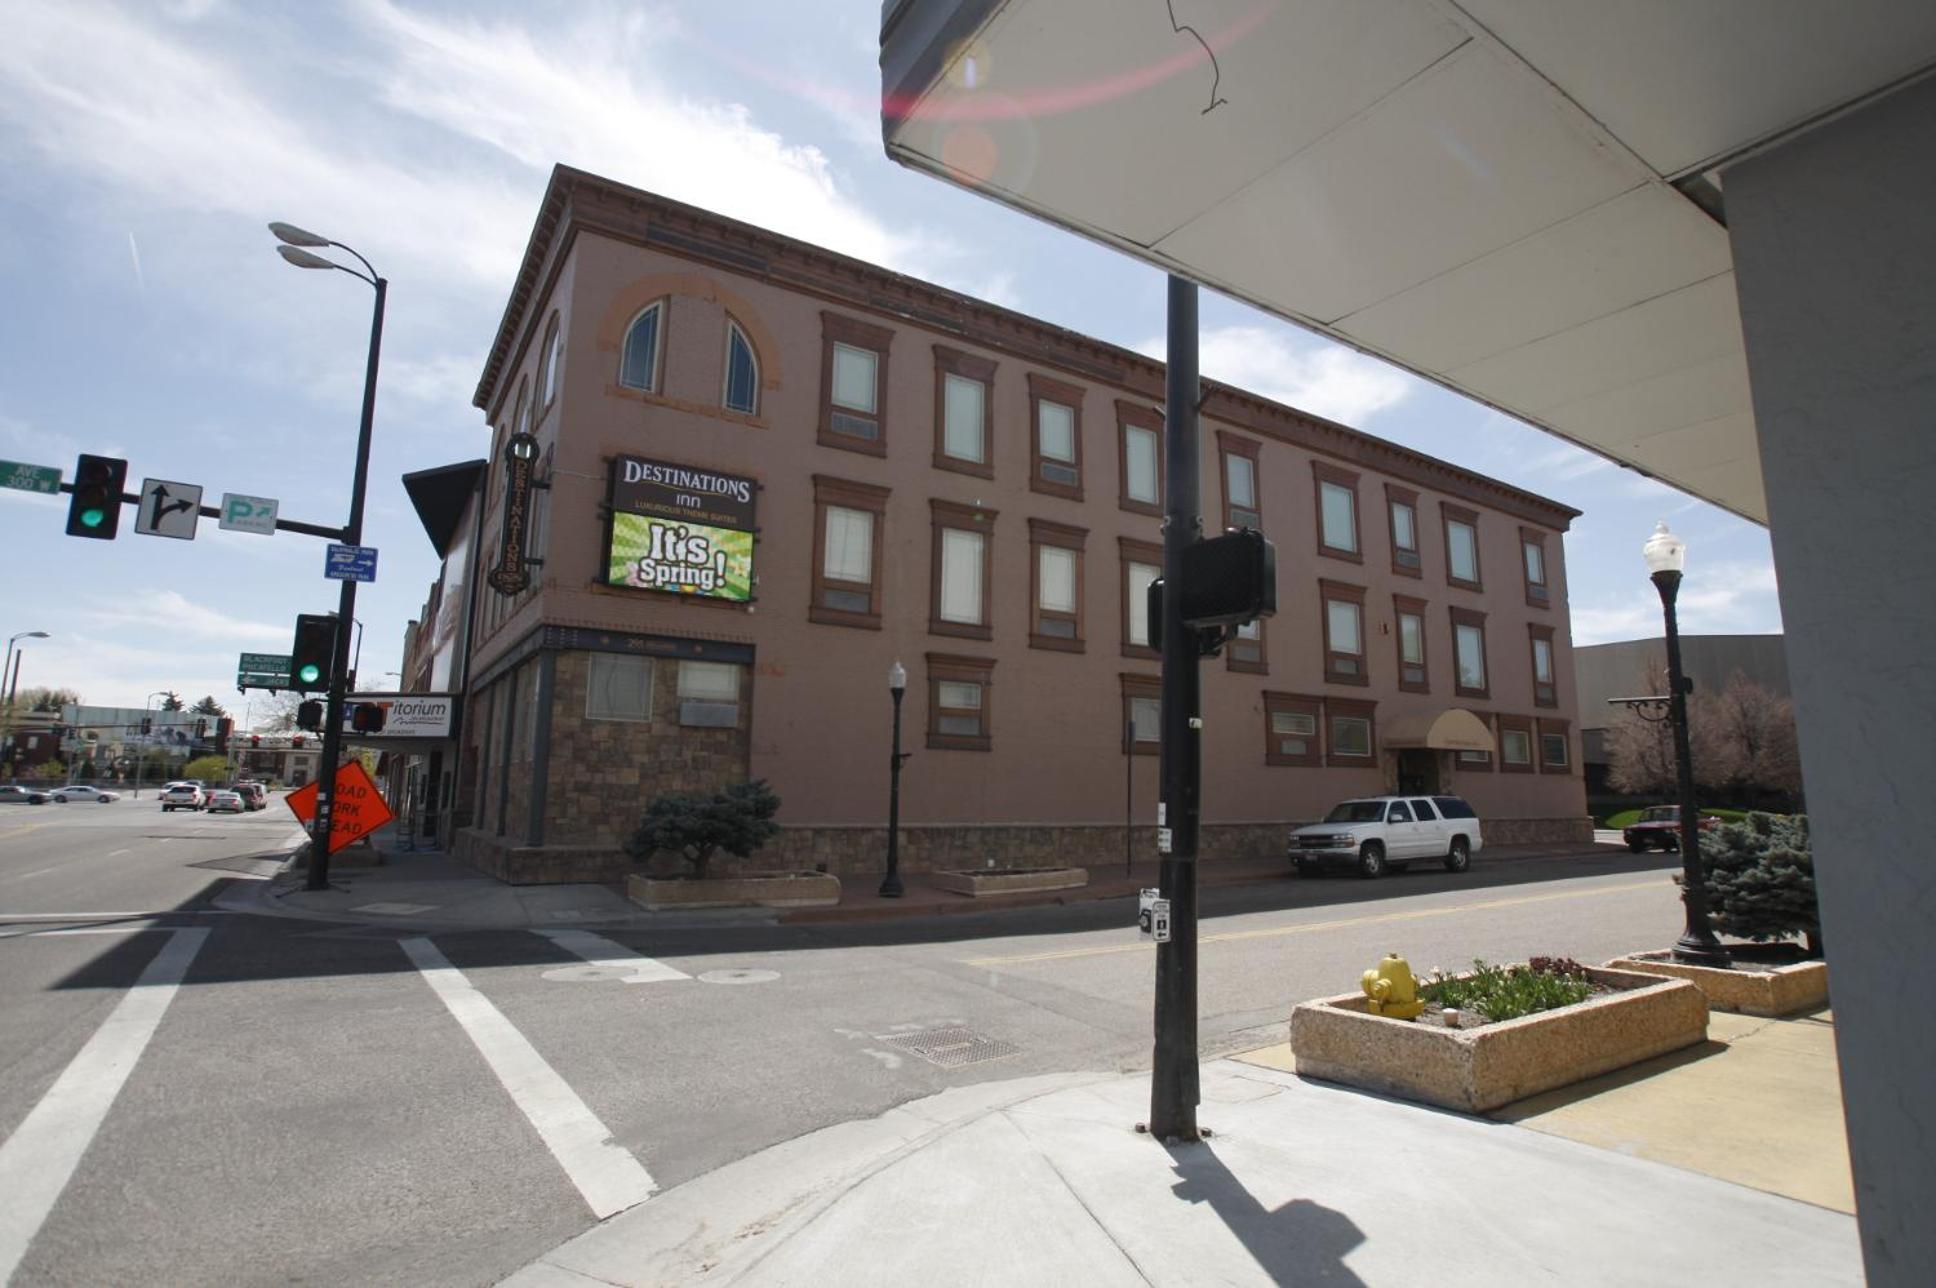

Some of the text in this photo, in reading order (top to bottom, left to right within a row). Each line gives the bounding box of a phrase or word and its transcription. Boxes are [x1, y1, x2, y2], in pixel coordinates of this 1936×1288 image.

[6, 475, 33, 489] 300
[15, 465, 41, 479] AVE
[624, 460, 750, 502] DESTINATIONS
[227, 499, 253, 524] P
[506, 461, 528, 572] DESTINATIONS
[650, 524, 708, 565] It's
[639, 550, 727, 591] Spring!
[336, 784, 367, 799] OAD
[333, 802, 361, 817] ORK
[332, 820, 361, 835] EAD
